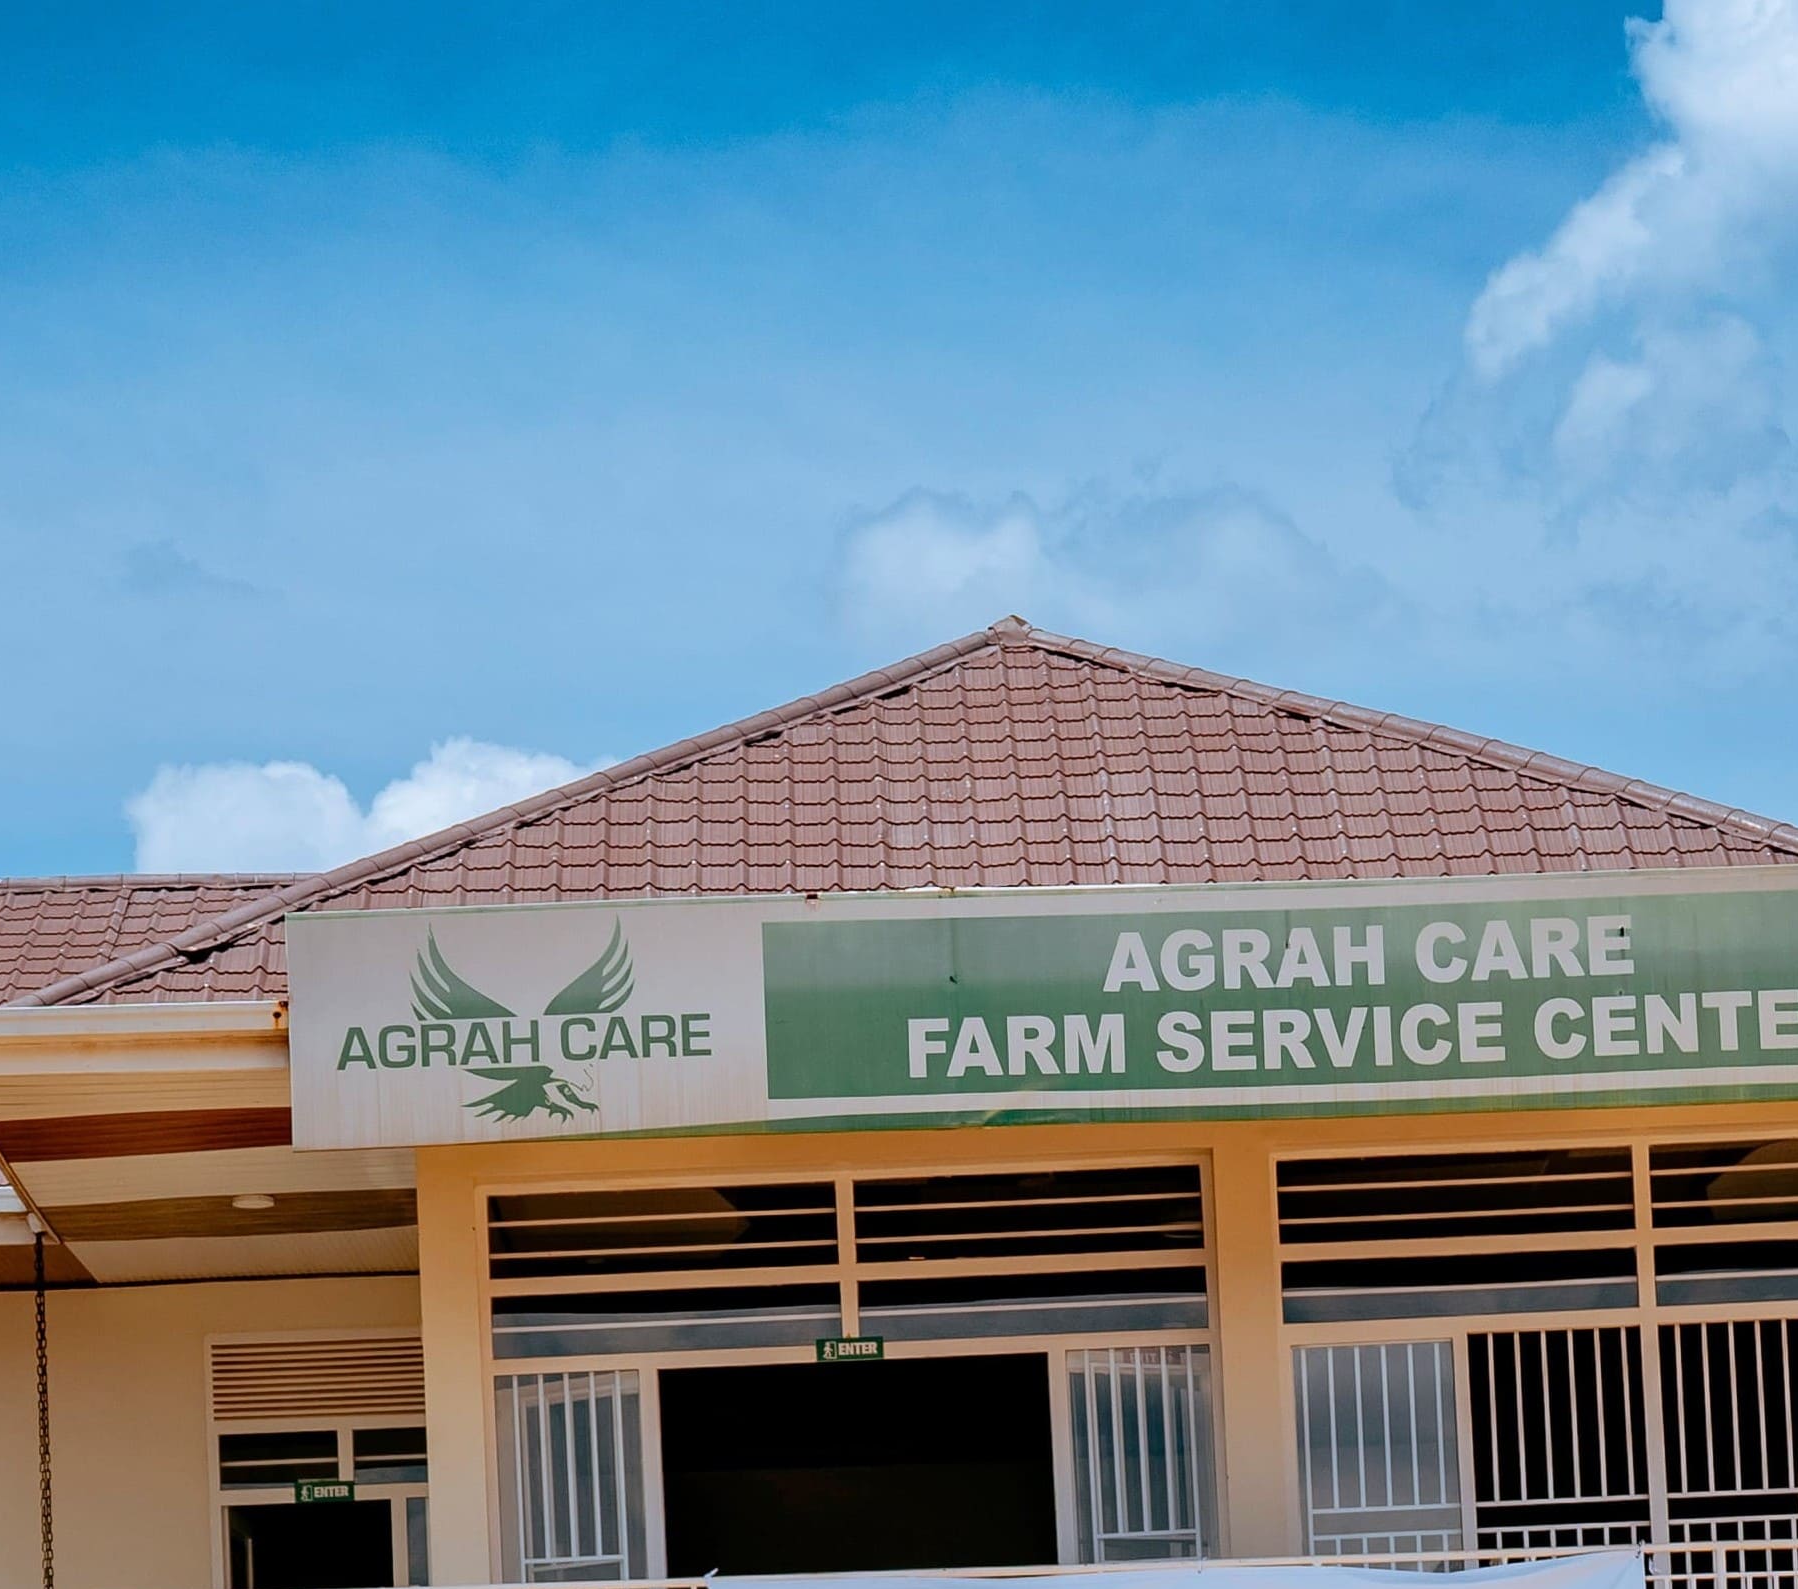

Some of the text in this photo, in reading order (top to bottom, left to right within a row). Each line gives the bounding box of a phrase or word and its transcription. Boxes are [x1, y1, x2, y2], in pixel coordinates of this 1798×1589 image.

[1103, 914, 1636, 993] AGRAH CARE
[337, 1012, 712, 1071] AGRAH CARE
[907, 1013, 1126, 1079] FARM
[1156, 1001, 1506, 1073] SERVICE
[838, 1341, 878, 1355] ENTER
[314, 1485, 349, 1498] ENTER
